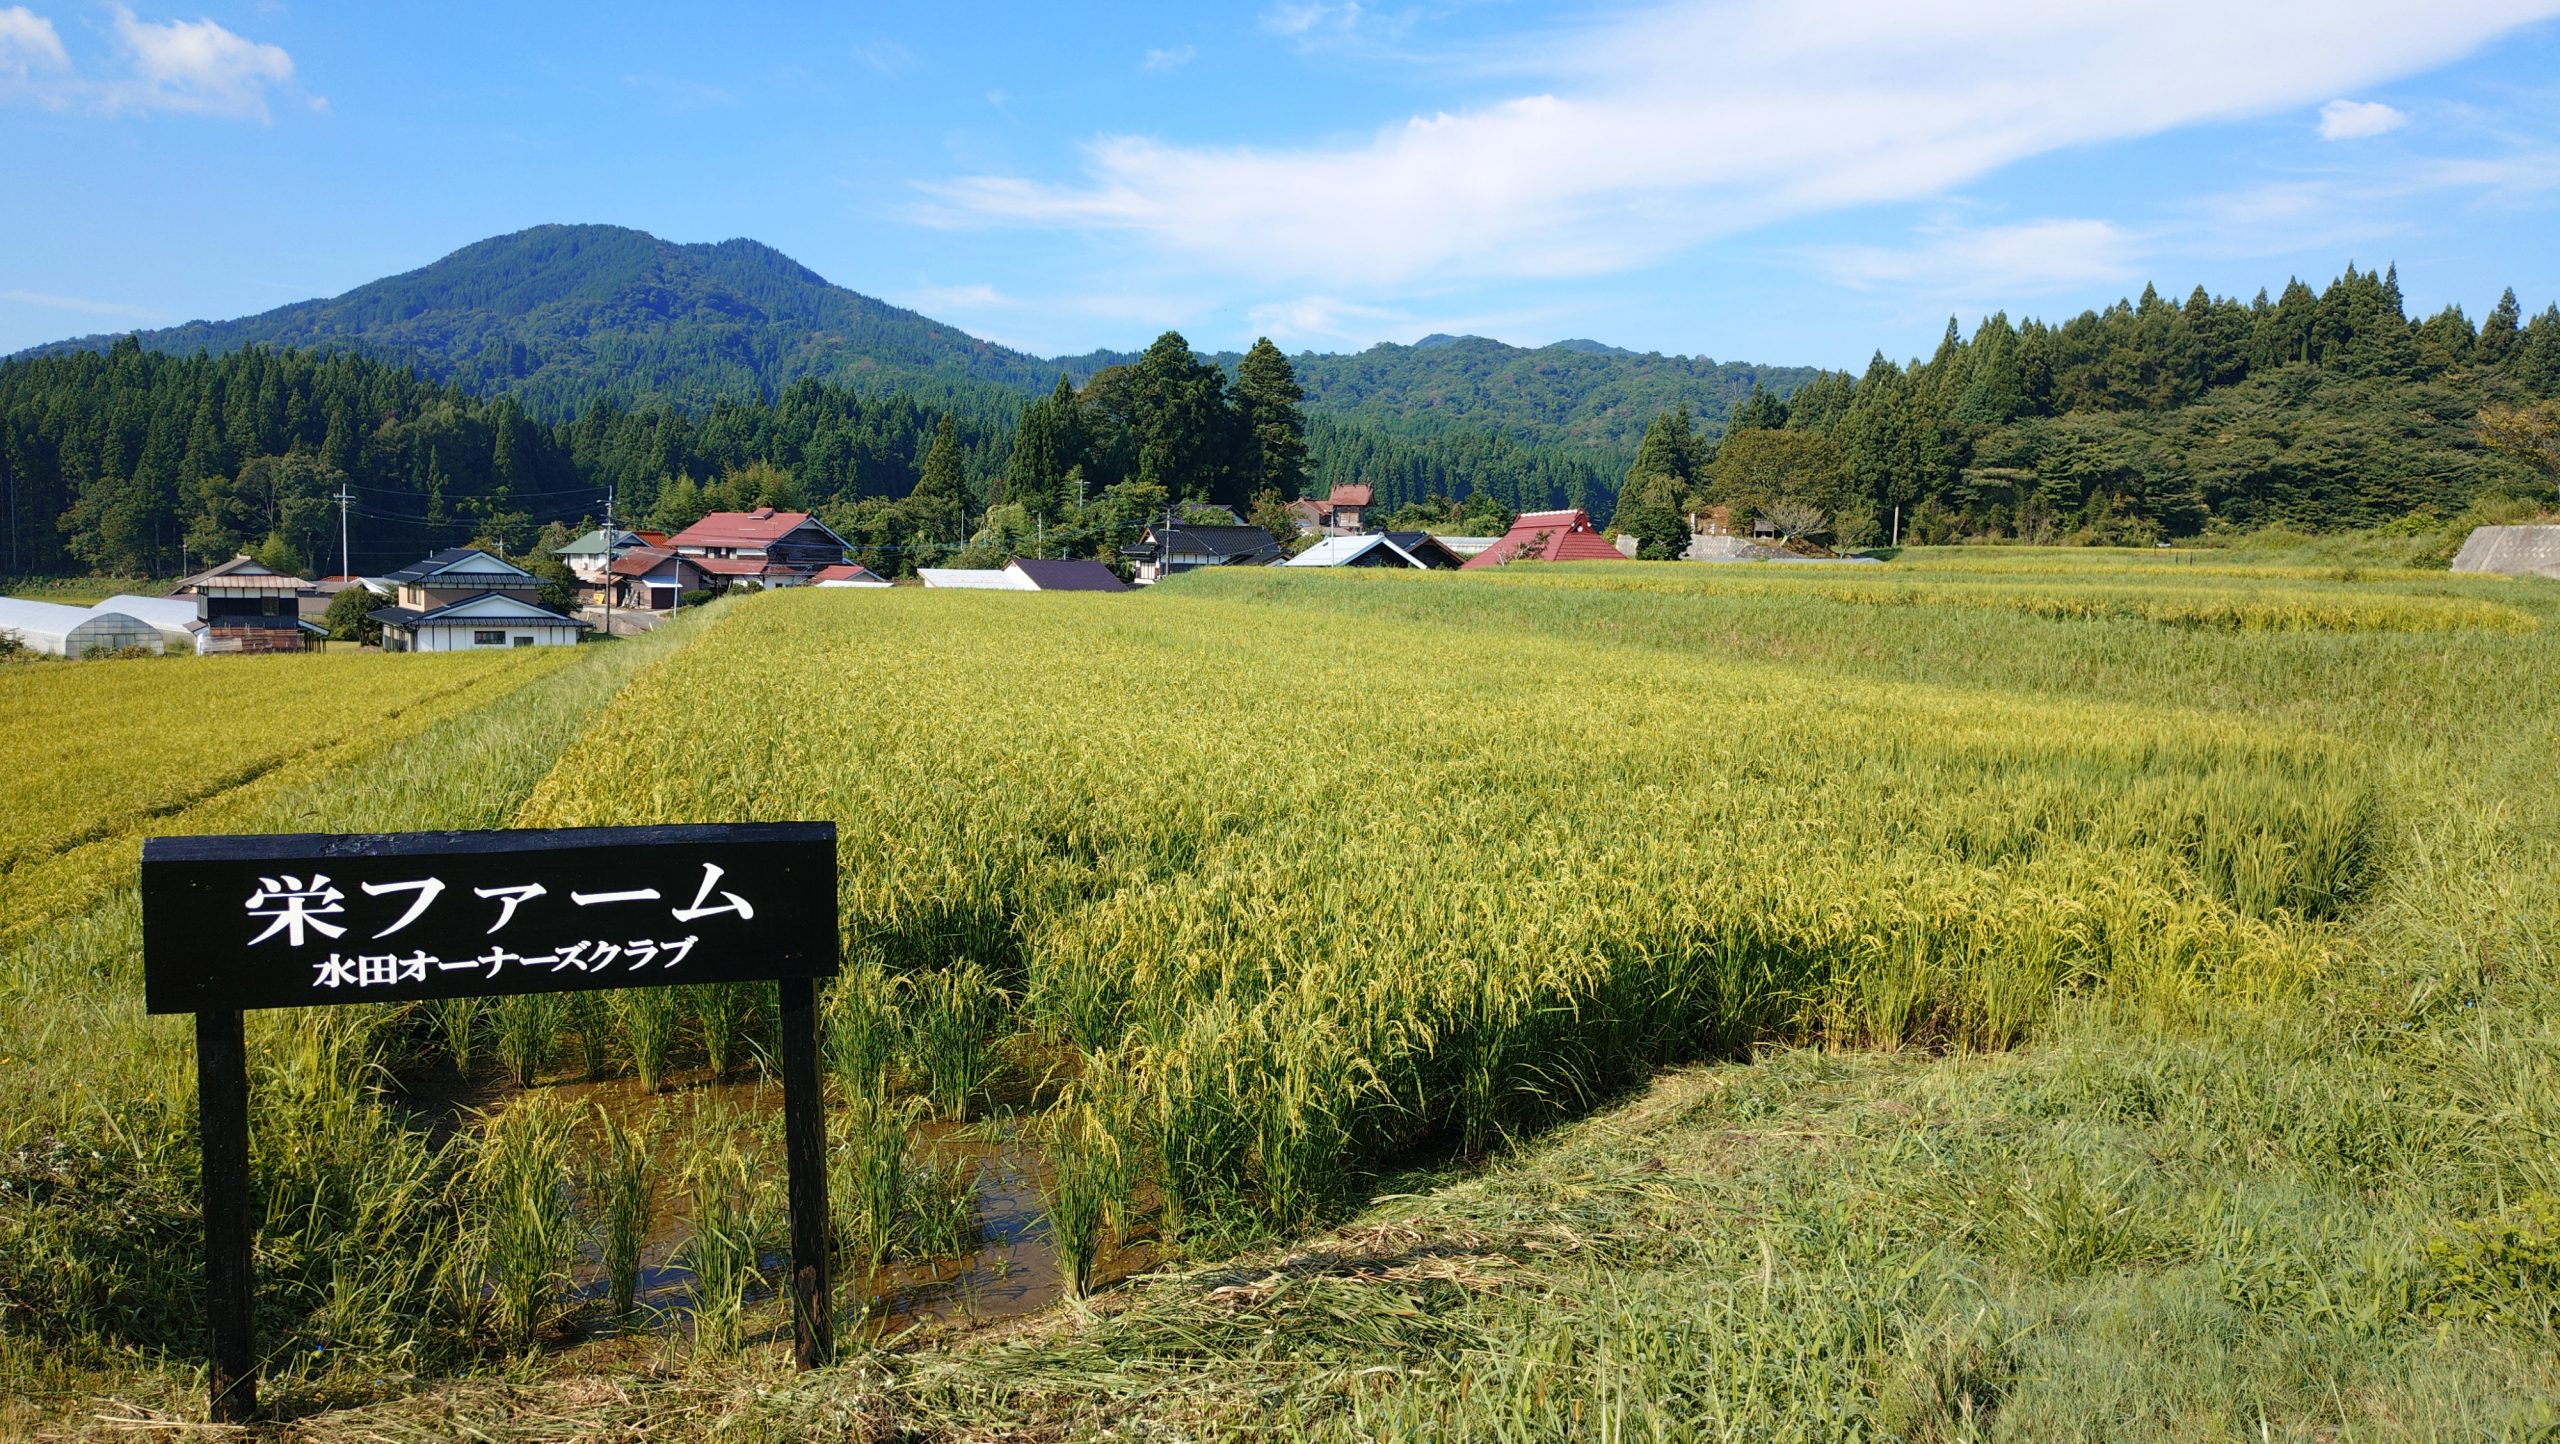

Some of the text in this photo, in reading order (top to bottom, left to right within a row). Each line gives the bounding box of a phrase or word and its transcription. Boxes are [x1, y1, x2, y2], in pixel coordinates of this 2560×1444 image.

[245, 862, 754, 947] 栄ファーム
[312, 935, 699, 988] 水田オーナーズクラブ
